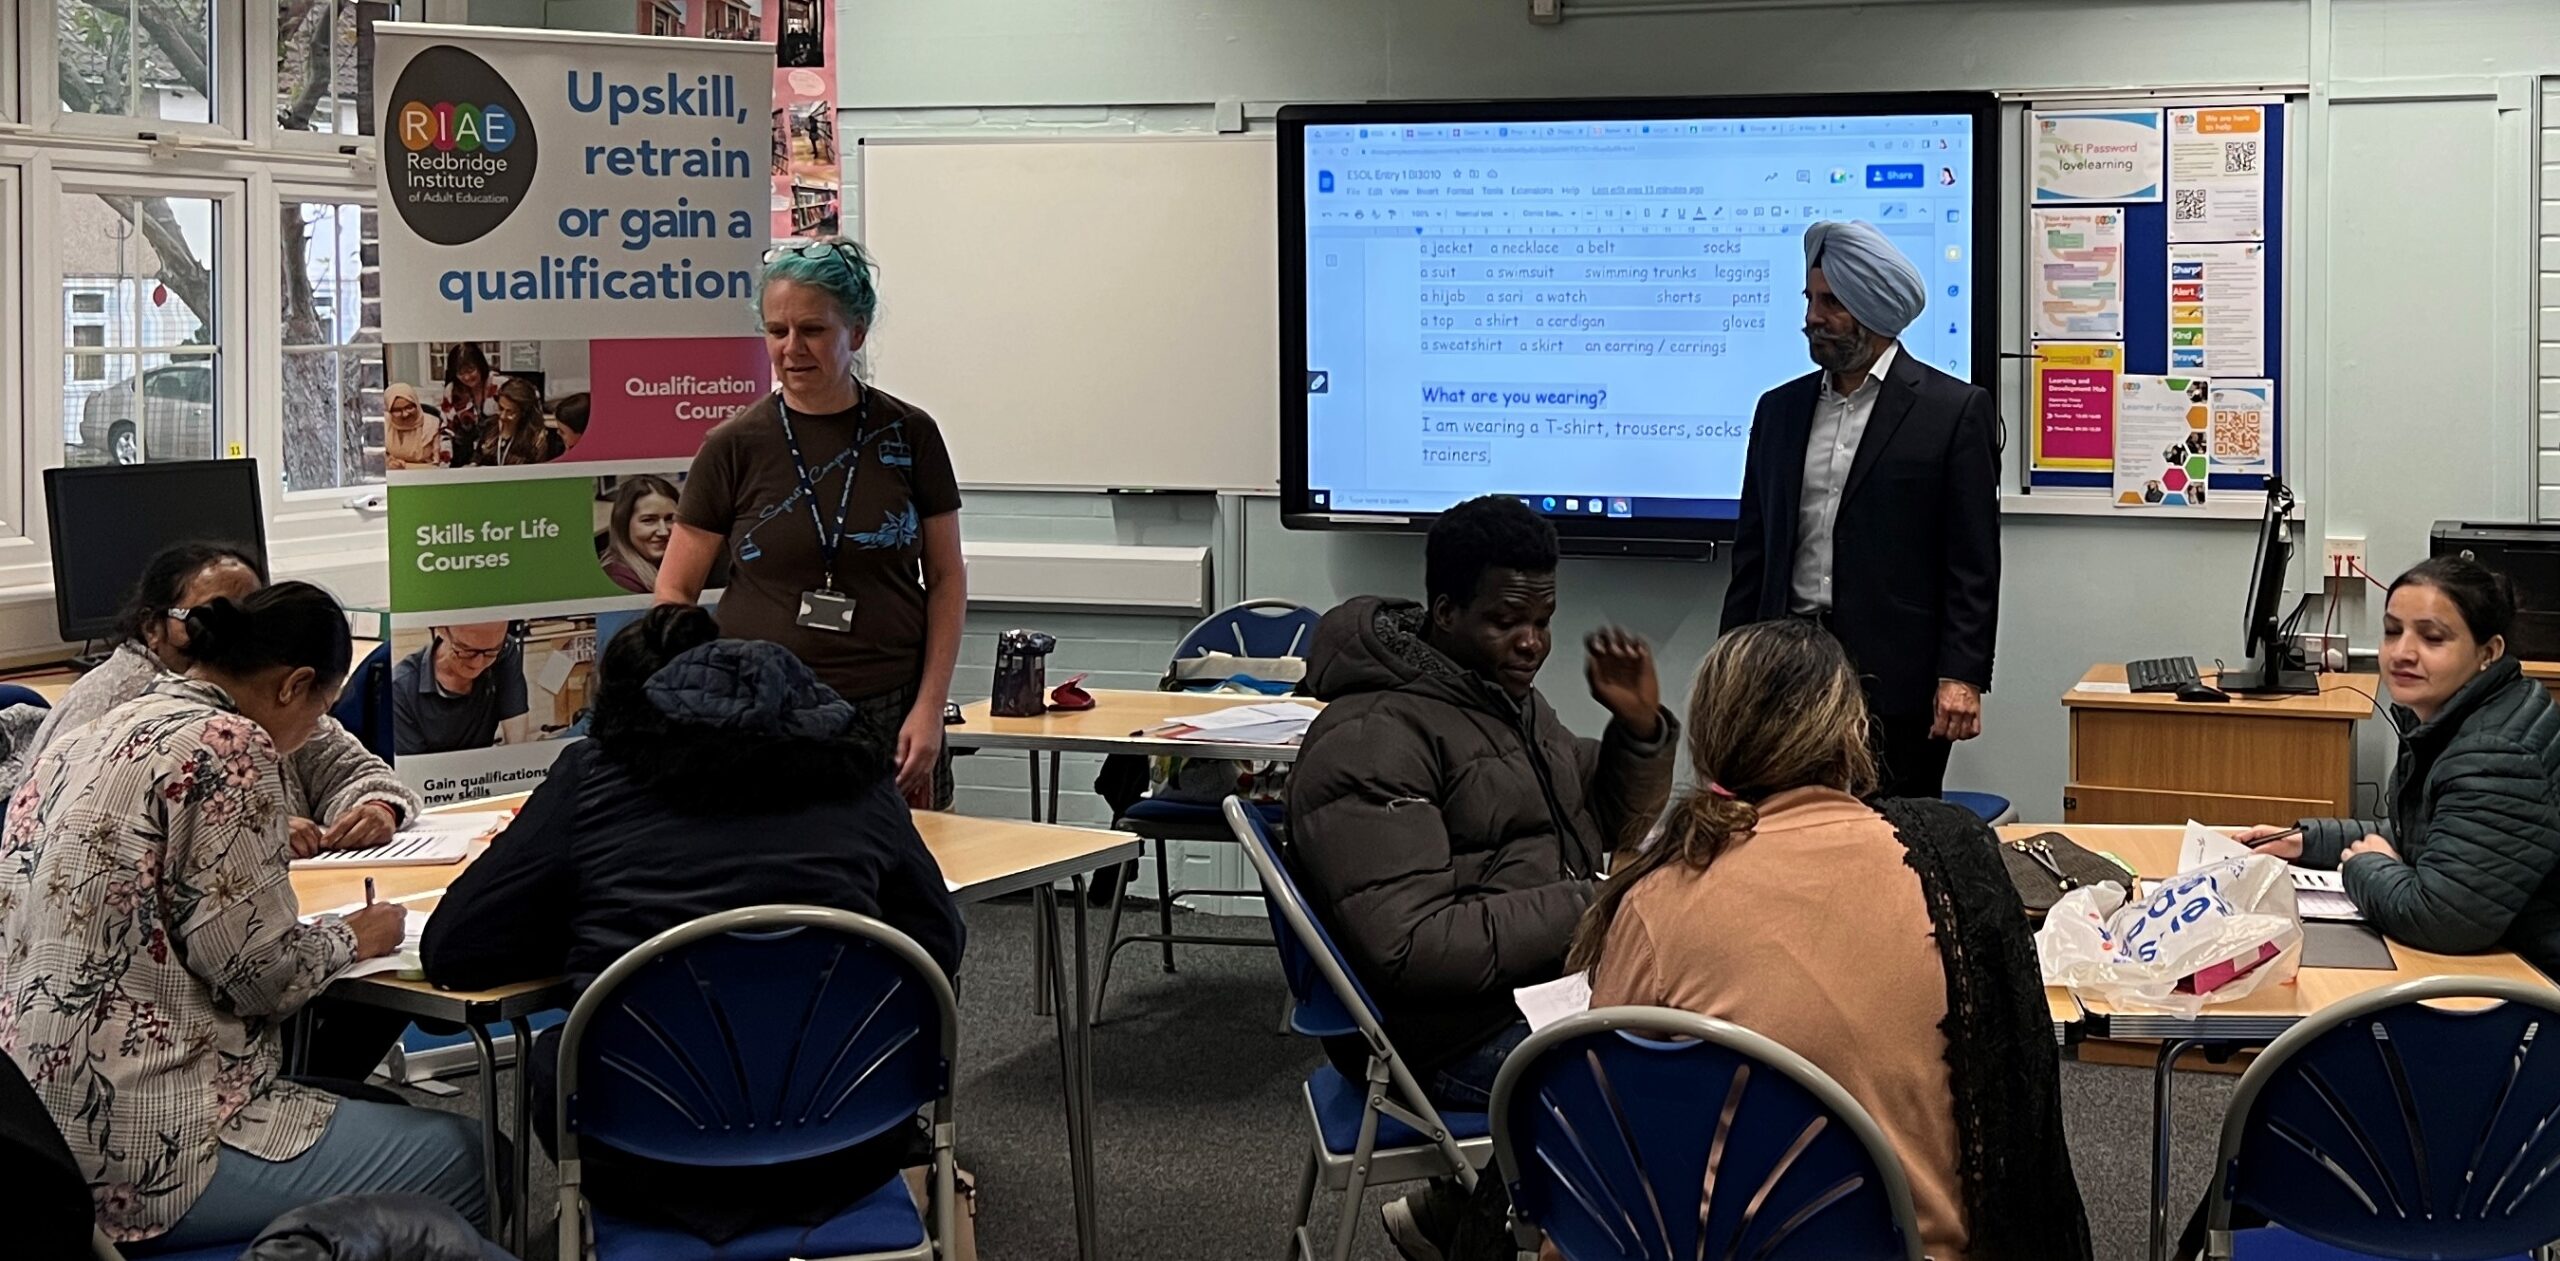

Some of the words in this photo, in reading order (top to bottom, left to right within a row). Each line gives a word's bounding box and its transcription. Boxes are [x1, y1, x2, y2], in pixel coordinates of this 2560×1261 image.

[567, 70, 748, 125] Upskill,
[405, 109, 507, 144] RIAE
[2086, 142, 2138, 154] Password
[407, 152, 508, 176] Redbridge
[585, 137, 751, 179] retrain
[2059, 158, 2133, 172] lovelearning
[407, 172, 485, 189] Institute
[1347, 169, 1373, 180] ESOL
[1375, 169, 1400, 182] Entry
[1886, 170, 1914, 181] Share
[408, 191, 420, 203] of
[423, 192, 454, 203] Adult
[456, 192, 509, 204] Education
[558, 207, 609, 239] or
[620, 197, 717, 250] gain
[727, 207, 752, 239] a
[1420, 243, 1428, 254] a
[1431, 241, 1472, 258] jacket
[1490, 243, 1498, 254] a
[1502, 240, 1559, 254] necklace
[1576, 243, 1584, 254] a
[1588, 240, 1616, 254] belt
[1703, 240, 1741, 254] socks
[1420, 268, 1428, 278] a
[1431, 267, 1456, 278] suit
[1486, 268, 1494, 278] a
[1498, 266, 1555, 278] swimsuit
[1585, 265, 1648, 282] swimming
[1653, 266, 1697, 279] trunks
[1715, 264, 1770, 282] leggings
[438, 256, 752, 314] qualification
[2172, 287, 2195, 297] Alert
[1420, 293, 1428, 303] a
[1432, 289, 1465, 306] hijab
[1486, 293, 1494, 303] a
[1498, 292, 1523, 303] sari
[1536, 293, 1543, 303] a
[1547, 289, 1587, 303] watch
[1656, 289, 1702, 304] shorts
[1732, 292, 1770, 307] pants
[1420, 316, 1428, 326] a
[1433, 315, 1454, 330] top
[1475, 316, 1482, 326] a
[1486, 313, 1518, 326] shirt
[1536, 317, 1544, 327] a
[1547, 313, 1605, 331] cardigan
[1722, 314, 1765, 332] gloves
[1421, 340, 1428, 350] a
[1432, 338, 1502, 351] sweatshirt
[1520, 341, 1527, 351] a
[1532, 339, 1563, 351] skirt
[1585, 342, 1601, 353] an
[1605, 340, 1654, 356] earring
[1670, 340, 1726, 357] earrings
[625, 376, 756, 397] Qualification
[1422, 387, 1465, 403] What
[1471, 391, 1498, 403] are
[1502, 391, 1531, 407] you
[1535, 389, 1607, 409] wearing?
[1422, 417, 1430, 432] I
[1436, 420, 1458, 433] am
[1463, 419, 1525, 438] wearing
[1530, 422, 1539, 433] a
[1545, 418, 1609, 438] T-shirt,
[1616, 420, 1690, 439] trousers,
[1695, 421, 1742, 437] socks
[416, 524, 475, 547] Skills
[481, 521, 514, 542] for
[520, 518, 560, 540] Life
[417, 552, 510, 573] Courses
[424, 778, 456, 791] Gain
[460, 768, 549, 790] qualifications
[424, 793, 454, 804] new
[459, 786, 490, 800] skills
